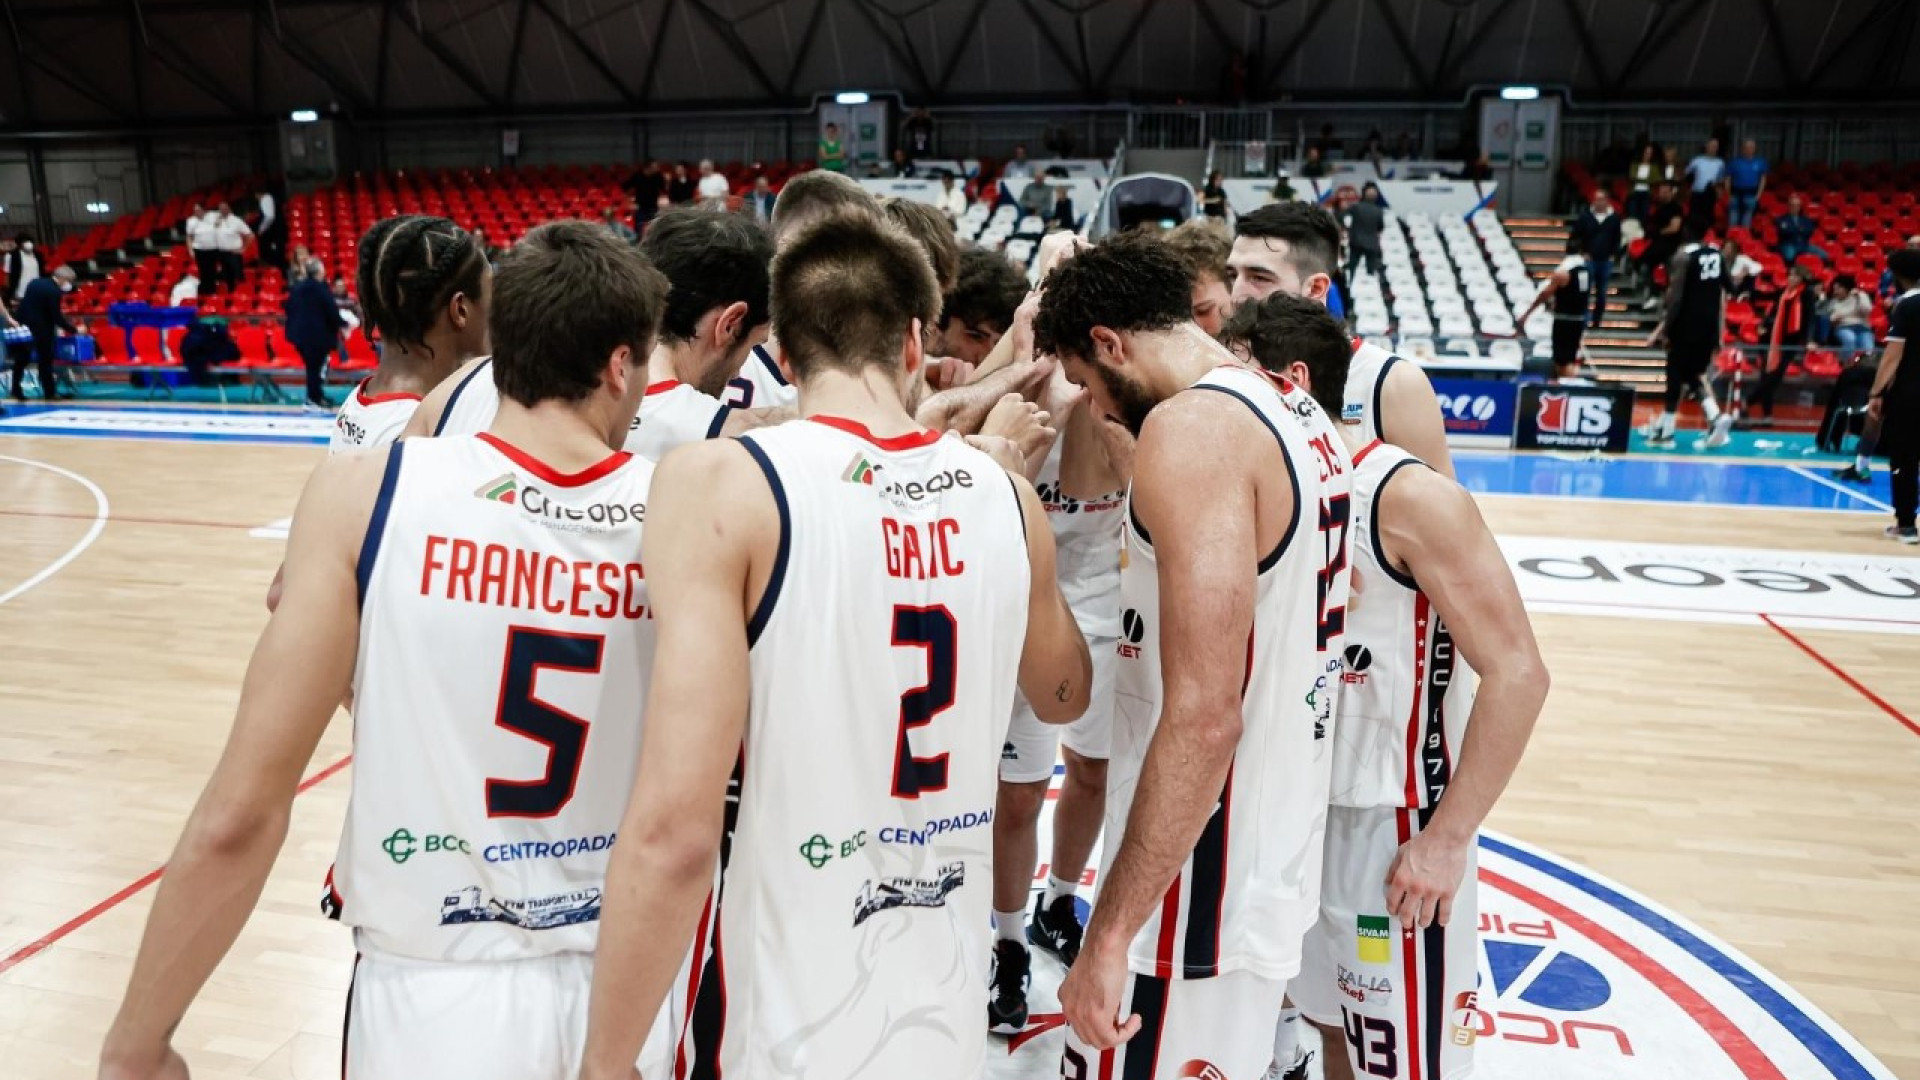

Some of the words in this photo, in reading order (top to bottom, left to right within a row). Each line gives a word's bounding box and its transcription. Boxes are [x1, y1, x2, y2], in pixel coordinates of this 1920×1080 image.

[420, 534, 653, 620] FRANCESC
[484, 624, 606, 819] 5
[891, 603, 958, 799] 2
[1357, 926, 1390, 938] SIVAM
[1341, 1004, 1398, 1080] 43
